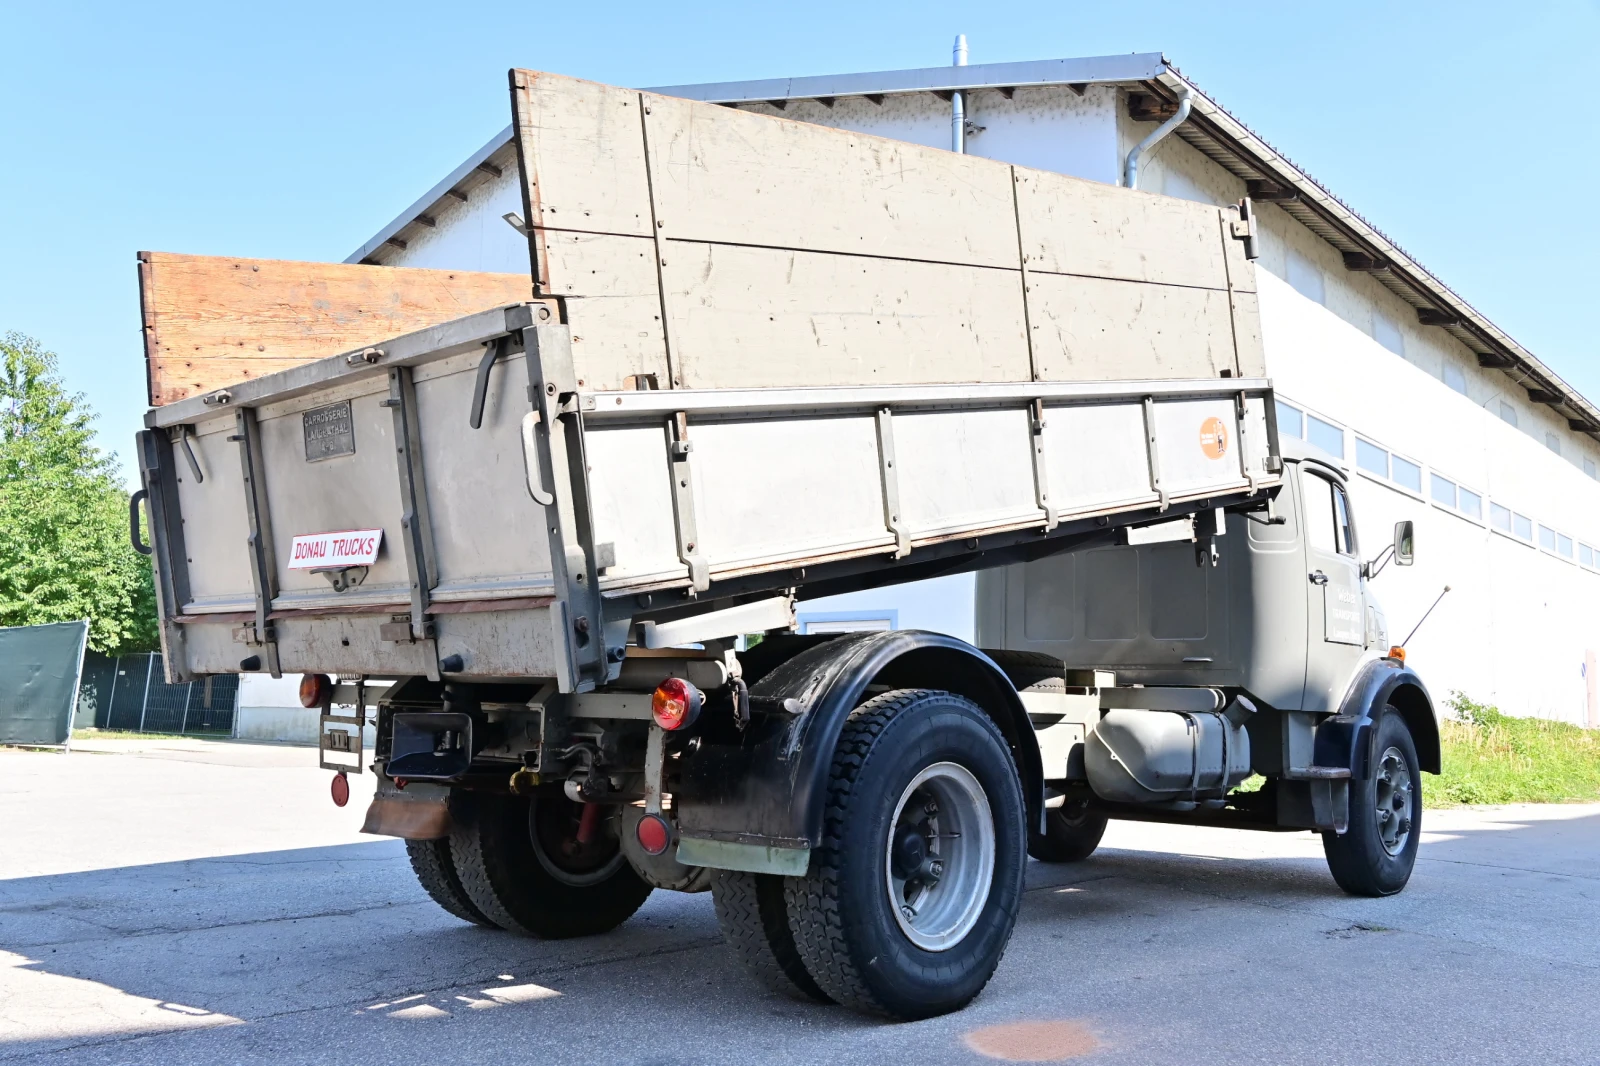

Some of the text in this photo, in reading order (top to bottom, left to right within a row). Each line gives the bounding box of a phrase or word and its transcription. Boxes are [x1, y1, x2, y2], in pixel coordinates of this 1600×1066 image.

[304, 407, 348, 427] CARROSSERIE
[295, 538, 375, 559] DONAU TRUCKS
